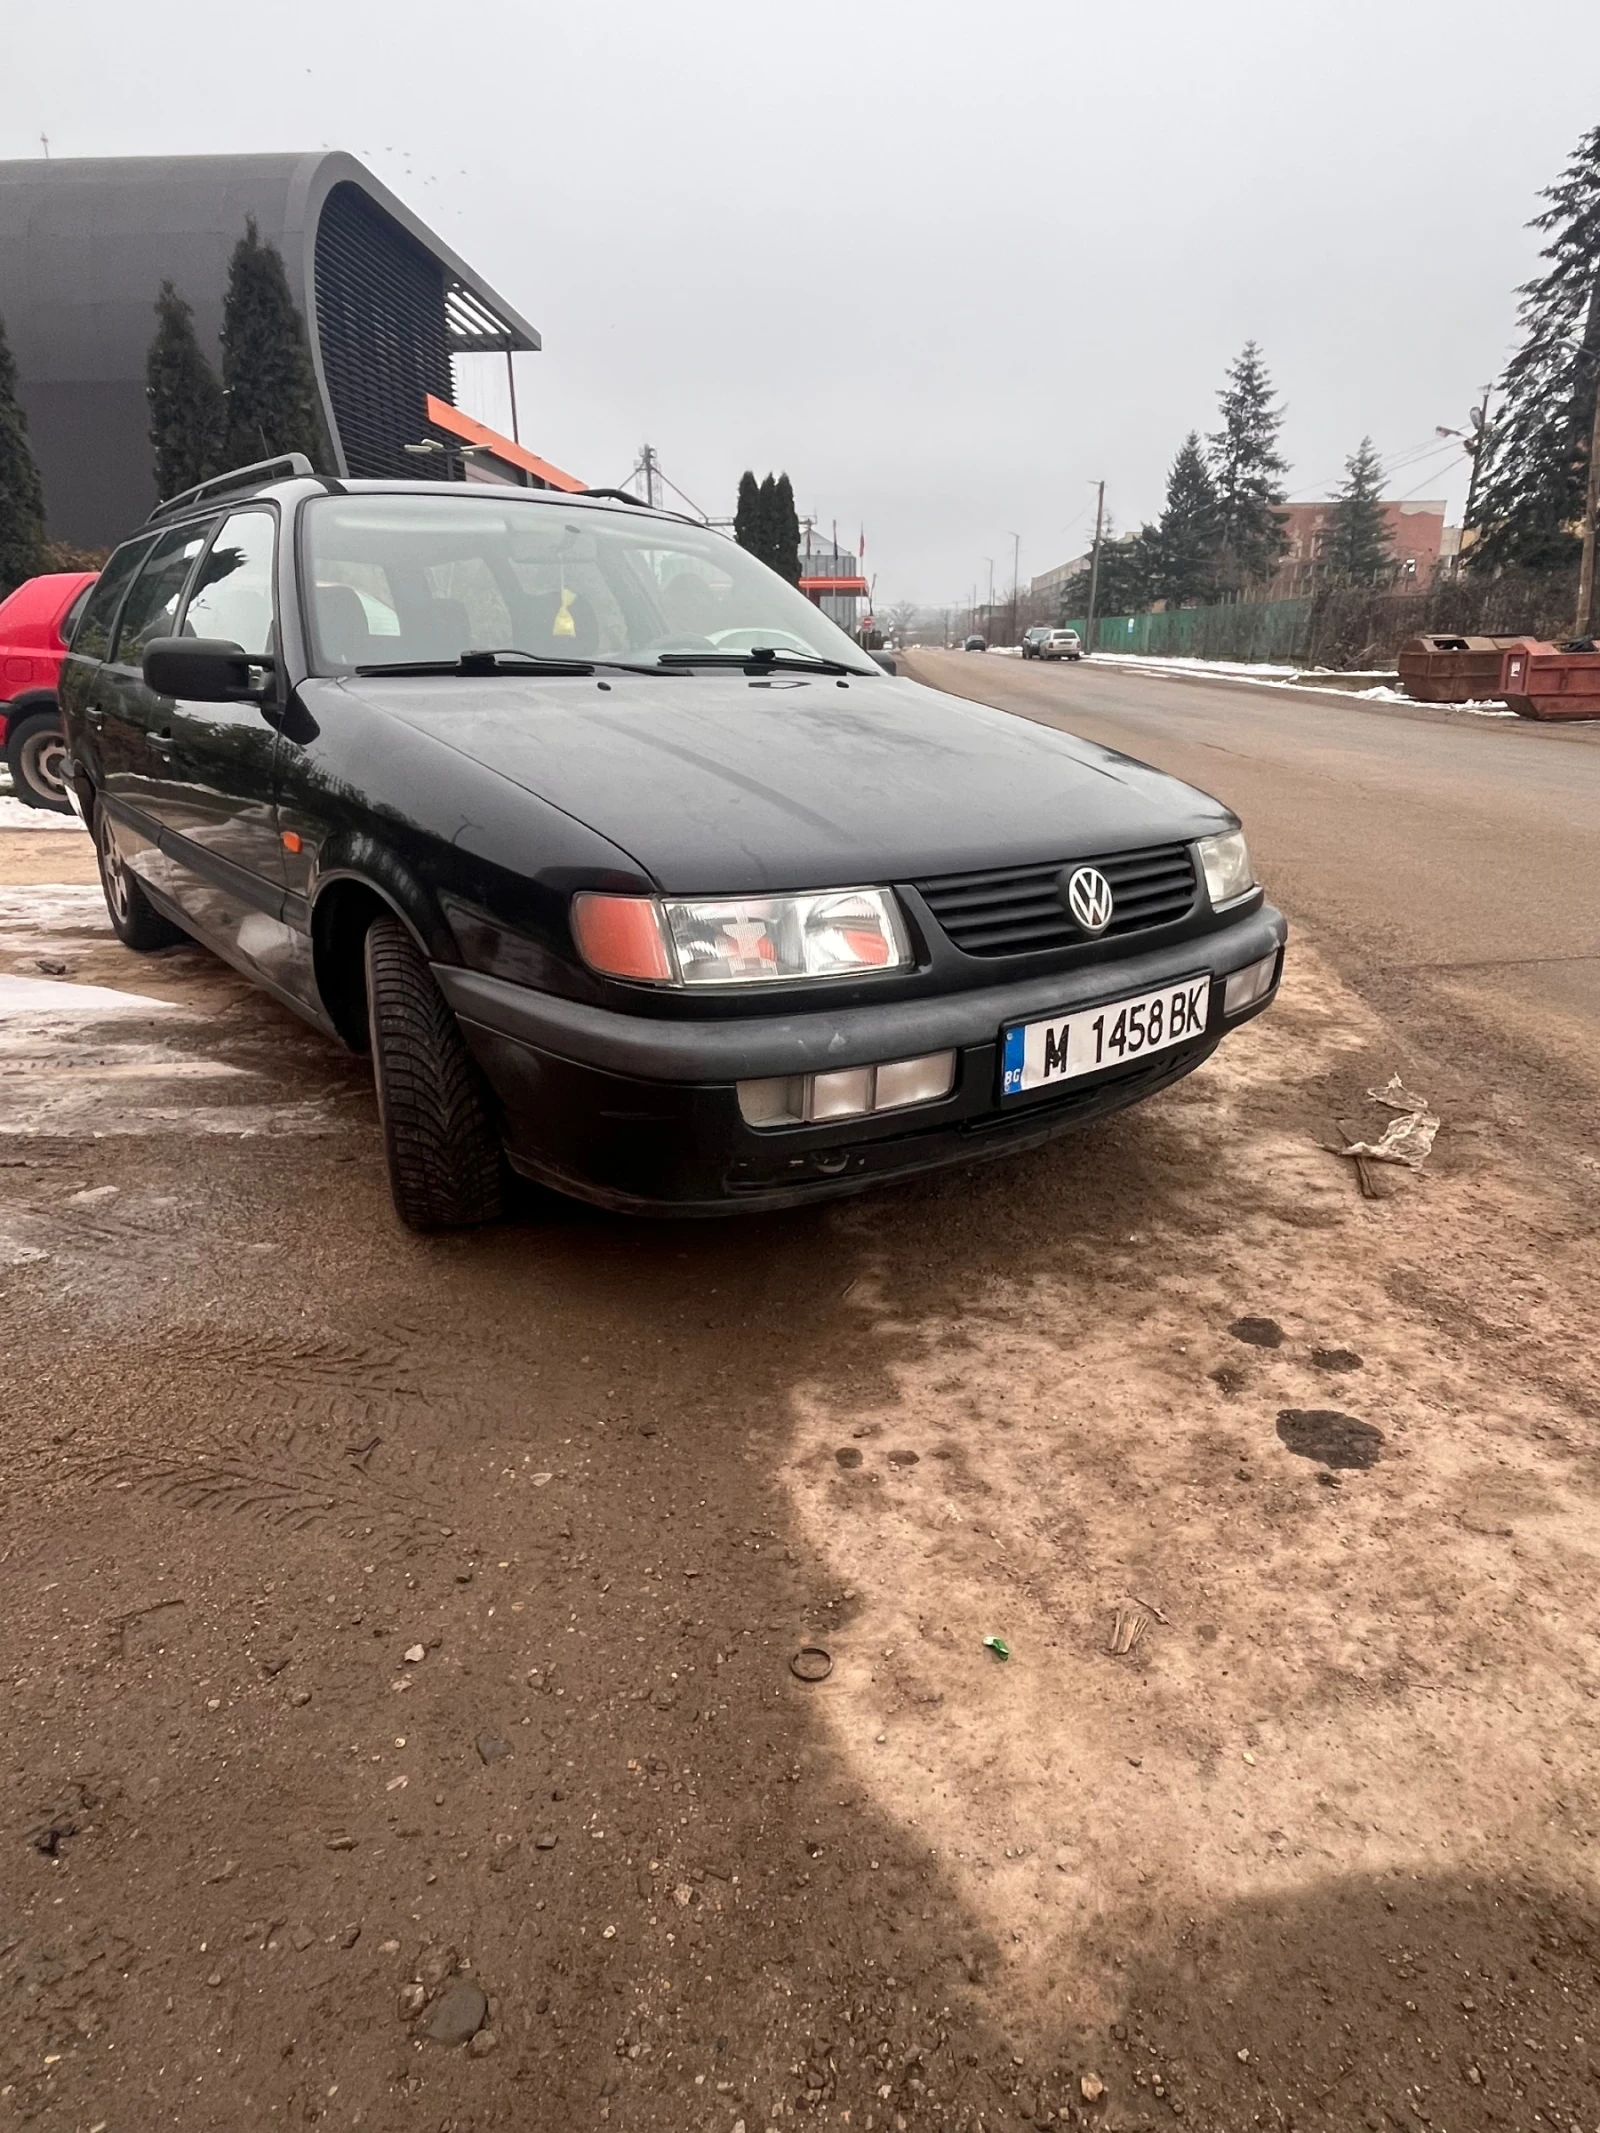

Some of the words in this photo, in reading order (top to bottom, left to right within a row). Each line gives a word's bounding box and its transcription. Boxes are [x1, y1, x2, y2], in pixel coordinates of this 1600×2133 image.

[1069, 867, 1113, 930] VW
[1044, 1024, 1070, 1078] M
[1092, 999, 1163, 1063] 1458
[1169, 984, 1205, 1039] BK
[1004, 1068, 1021, 1085] BG
